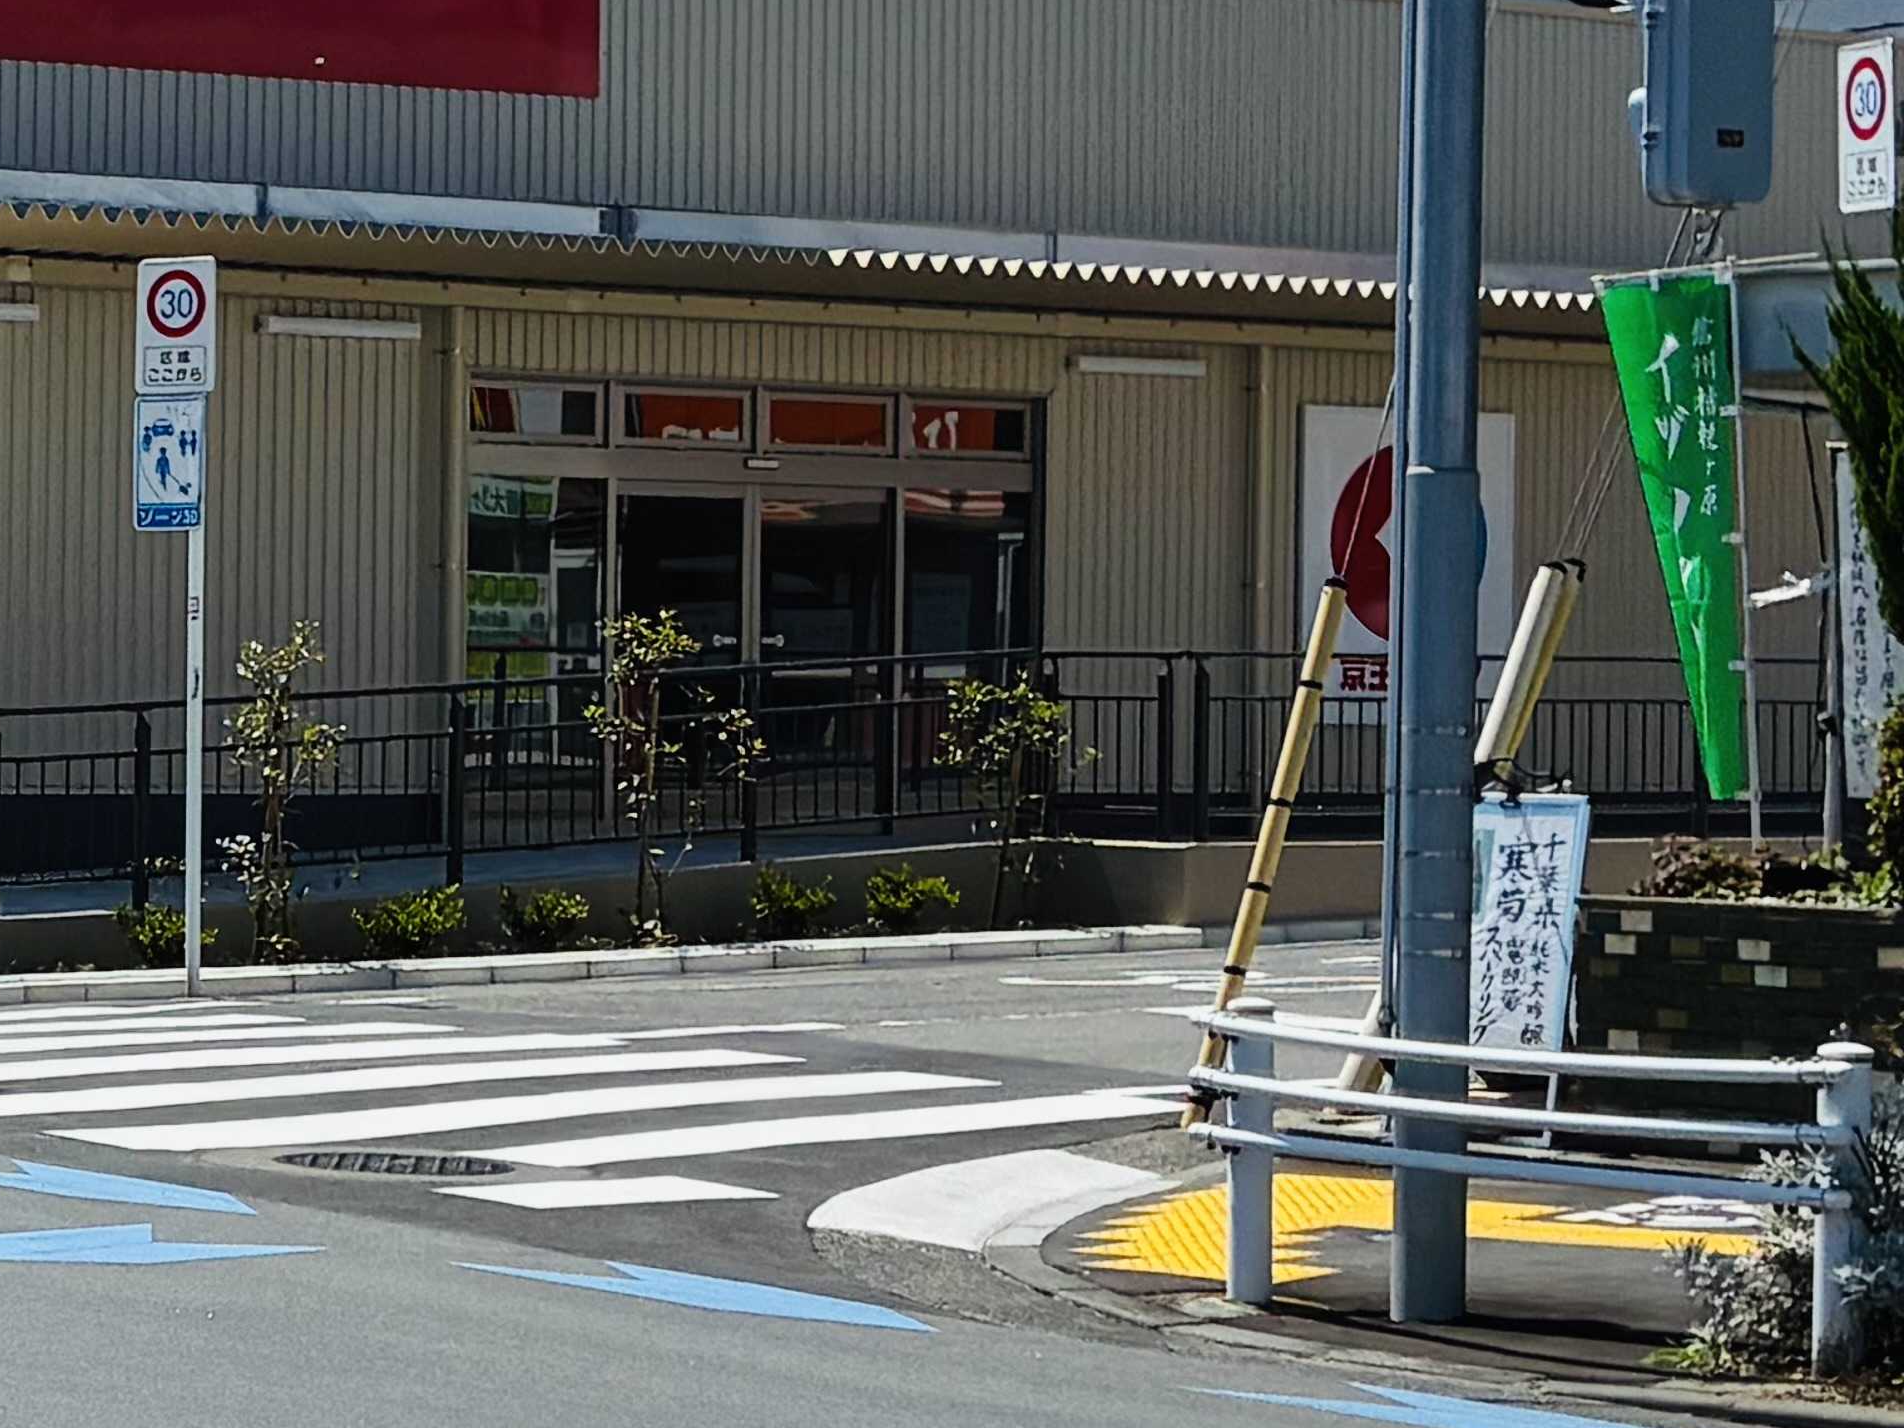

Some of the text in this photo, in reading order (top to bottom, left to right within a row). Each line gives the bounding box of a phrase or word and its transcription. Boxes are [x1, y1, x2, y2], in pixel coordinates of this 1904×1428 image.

[1854, 80, 1877, 118] 30
[160, 289, 193, 319] 30
[148, 367, 202, 382] ここから
